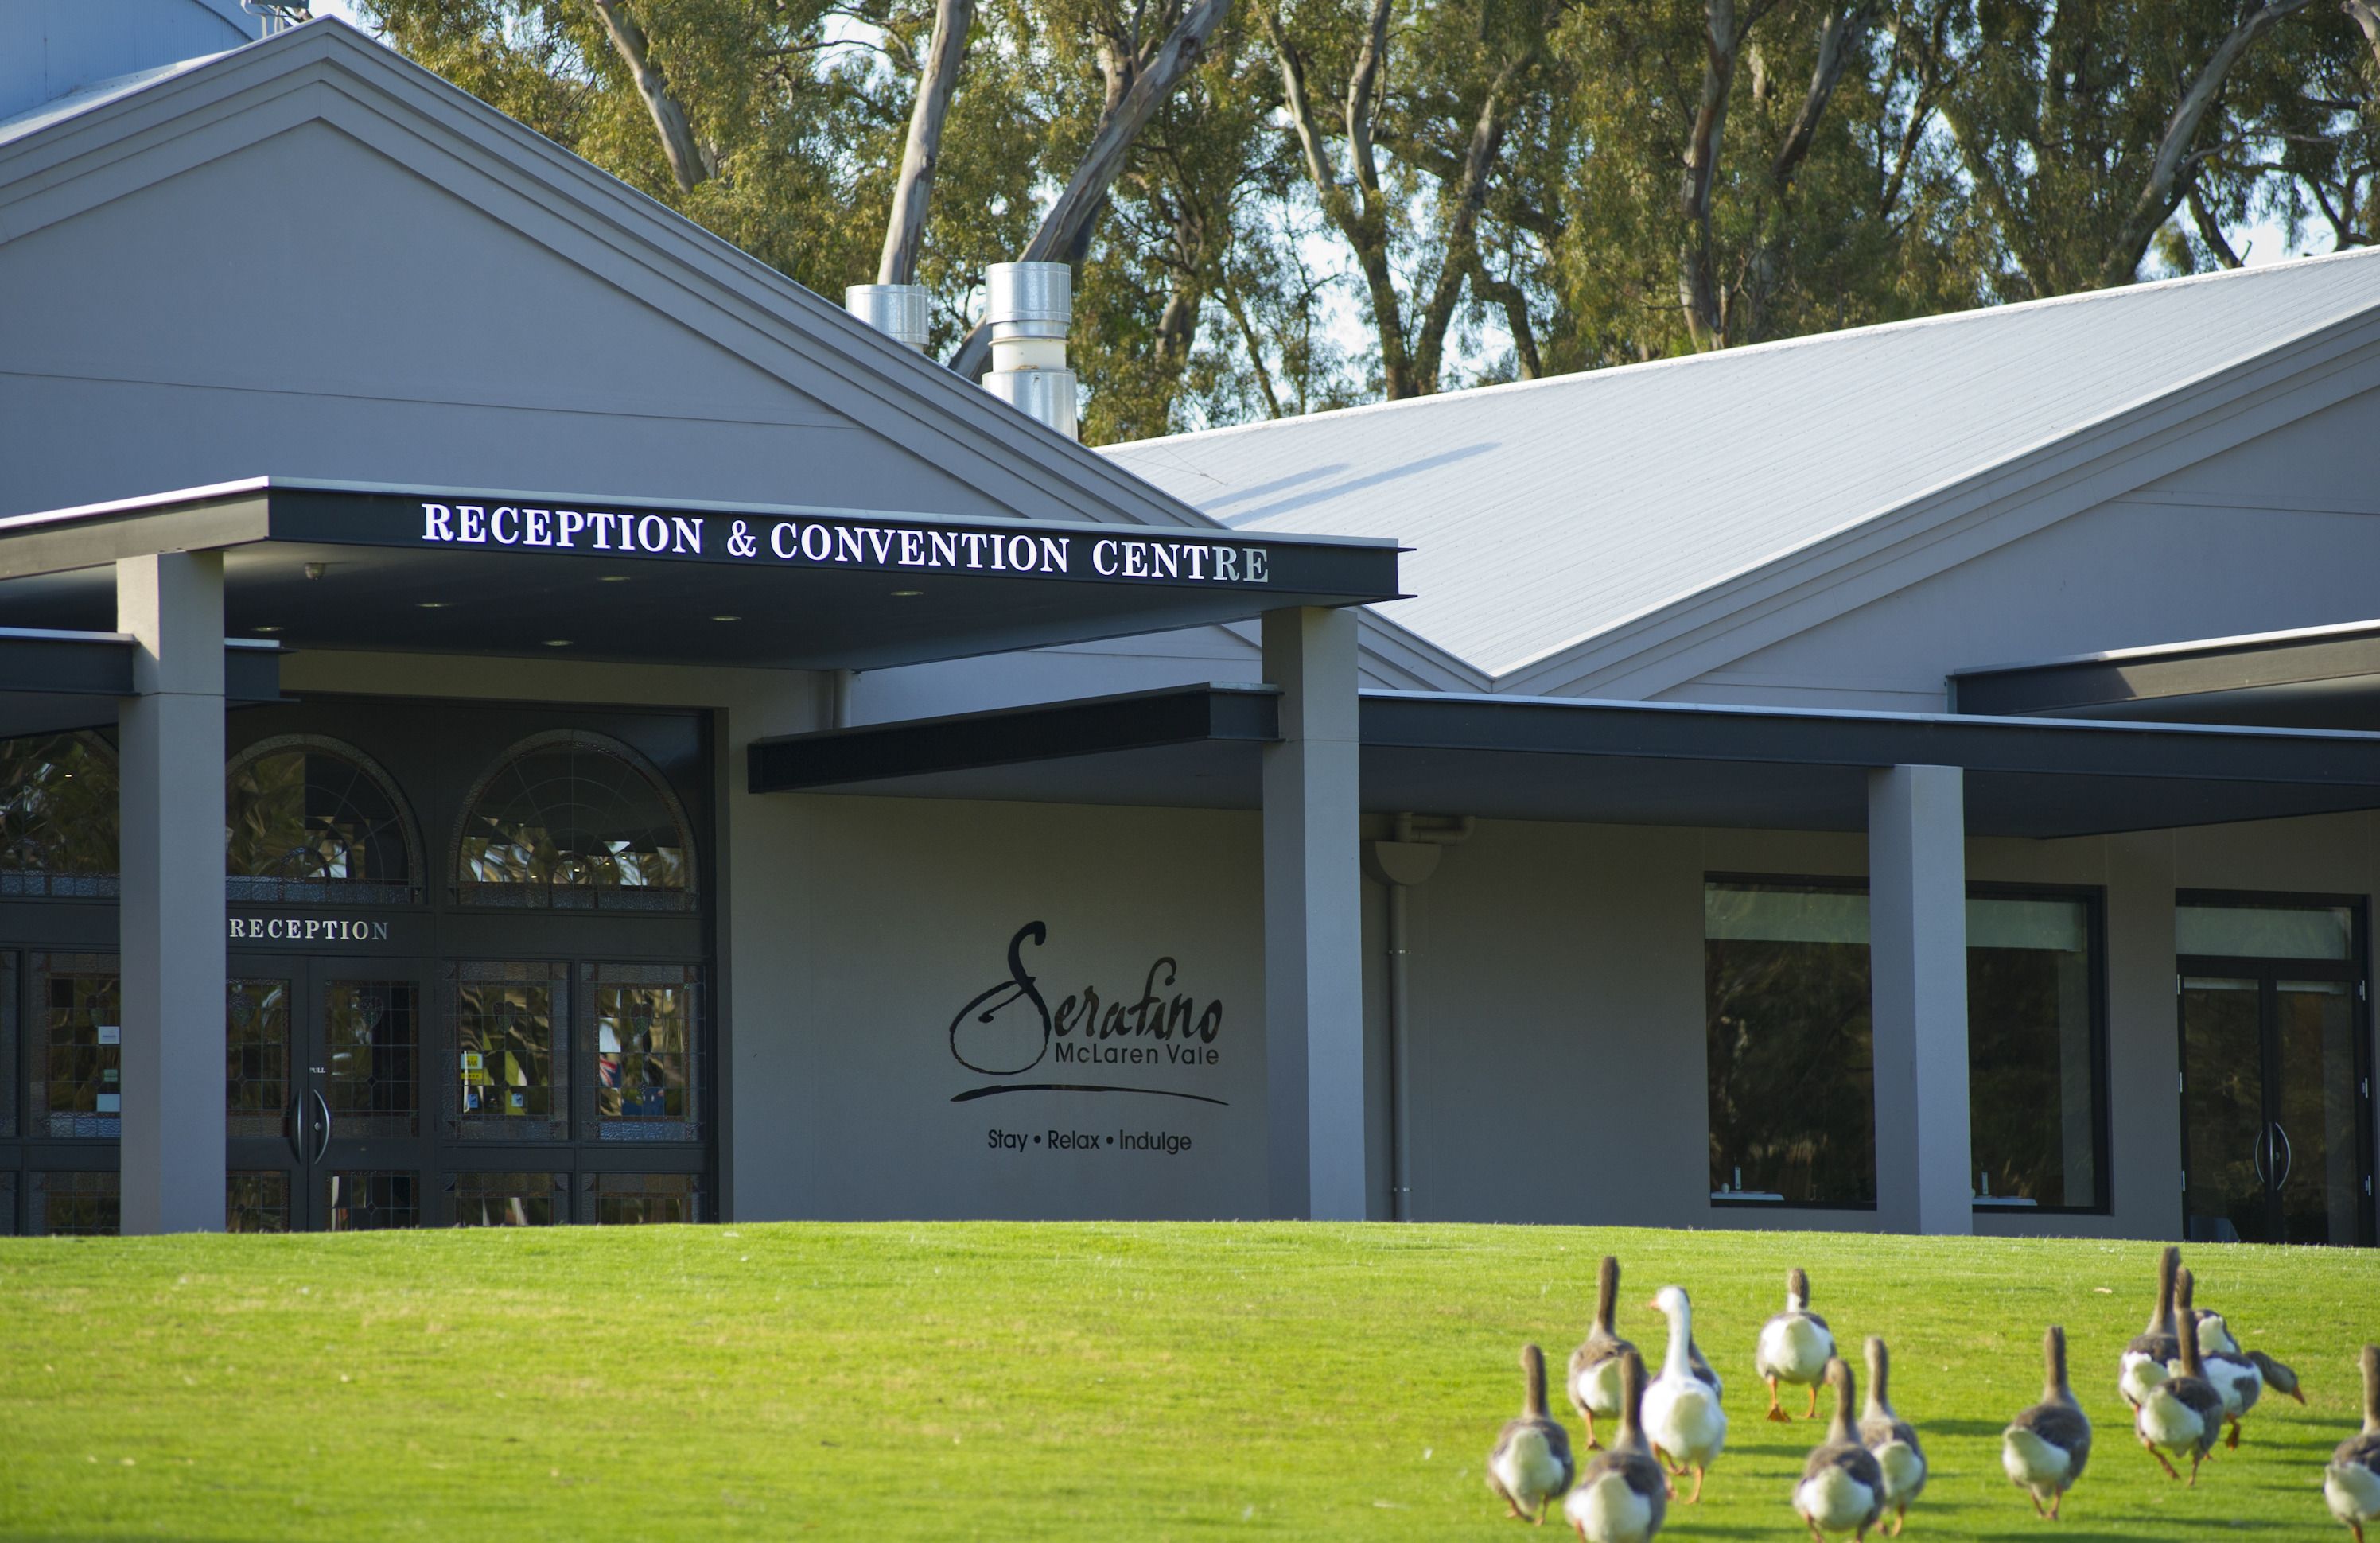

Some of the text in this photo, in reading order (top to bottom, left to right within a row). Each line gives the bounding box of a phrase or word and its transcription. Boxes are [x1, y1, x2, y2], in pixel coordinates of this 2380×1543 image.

[422, 503, 1269, 583] RECEPTION & CONVENTION CENTRE
[229, 919, 388, 940] RECEPTION
[950, 920, 1223, 1075] Serafino
[1055, 1043, 1219, 1065] McLaren Vale
[987, 1129, 1028, 1152] Stay
[1048, 1130, 1100, 1149] Relax
[1119, 1129, 1192, 1155] Indulge
